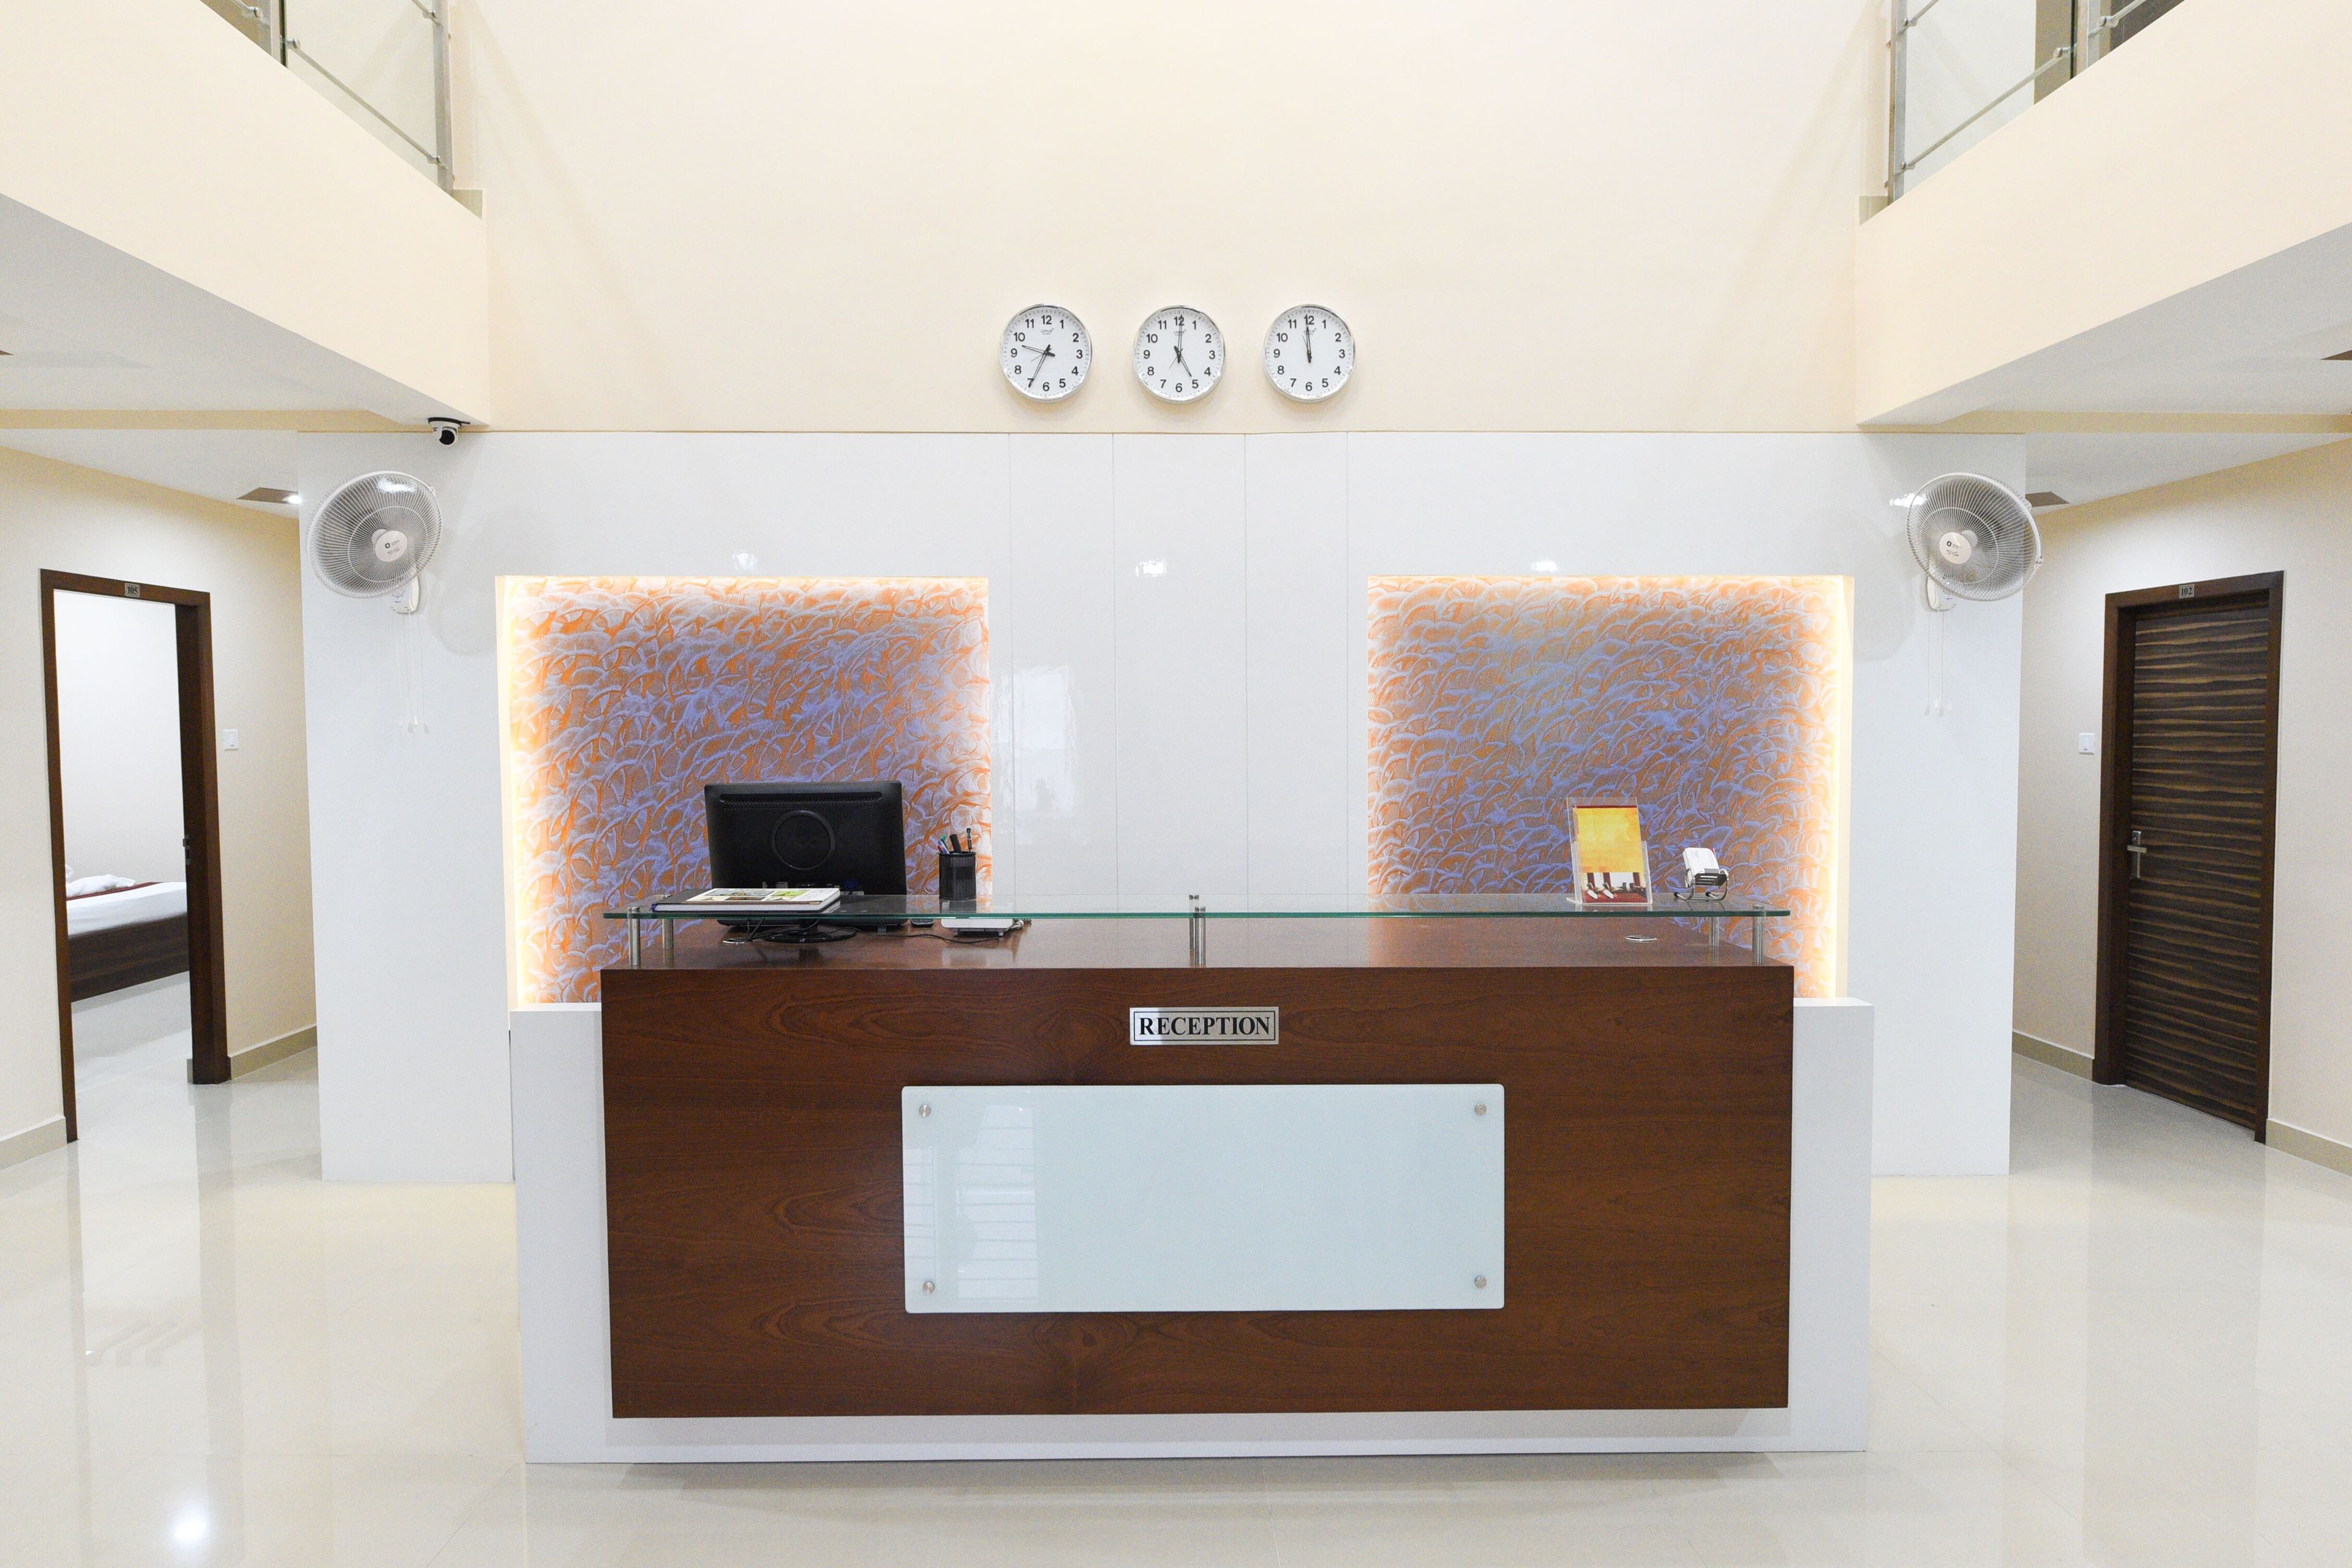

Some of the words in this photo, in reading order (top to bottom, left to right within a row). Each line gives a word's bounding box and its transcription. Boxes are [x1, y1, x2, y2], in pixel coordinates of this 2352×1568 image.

[1025, 318, 1034, 328] 11
[1041, 315, 1052, 325] 12
[1060, 320, 1063, 328] 1
[1158, 320, 1166, 329] 11
[1174, 315, 1185, 326] 12
[1288, 319, 1296, 328] 11
[1303, 315, 1314, 325] 12
[1322, 320, 1325, 328] 1
[1193, 320, 1196, 330] 1
[1014, 333, 1025, 341] 10
[1073, 333, 1079, 342] 2
[1147, 334, 1158, 343] 10
[1205, 334, 1211, 342] 2
[1276, 333, 1287, 342] 10
[1335, 333, 1341, 342] 2
[1011, 349, 1017, 357] 9
[1076, 350, 1082, 358] 3
[1144, 350, 1150, 358] 9
[1209, 350, 1215, 359] 3
[1274, 349, 1280, 358] 9
[1339, 349, 1345, 358] 3
[1015, 365, 1021, 374] 8
[1072, 366, 1079, 375] 4
[1147, 367, 1154, 375] 8
[1278, 366, 1284, 374] 8
[1334, 366, 1341, 375] 4
[1027, 378, 1035, 388] 7
[1043, 382, 1049, 391] 6
[1060, 379, 1066, 388] 5
[1176, 383, 1182, 392] 6
[1193, 380, 1198, 388] 5
[1306, 382, 1312, 391] 6
[1322, 379, 1328, 387] 5
[127, 586, 138, 595] 105
[2180, 587, 2192, 596] 102
[1139, 1017, 1270, 1035] RECEPTION
